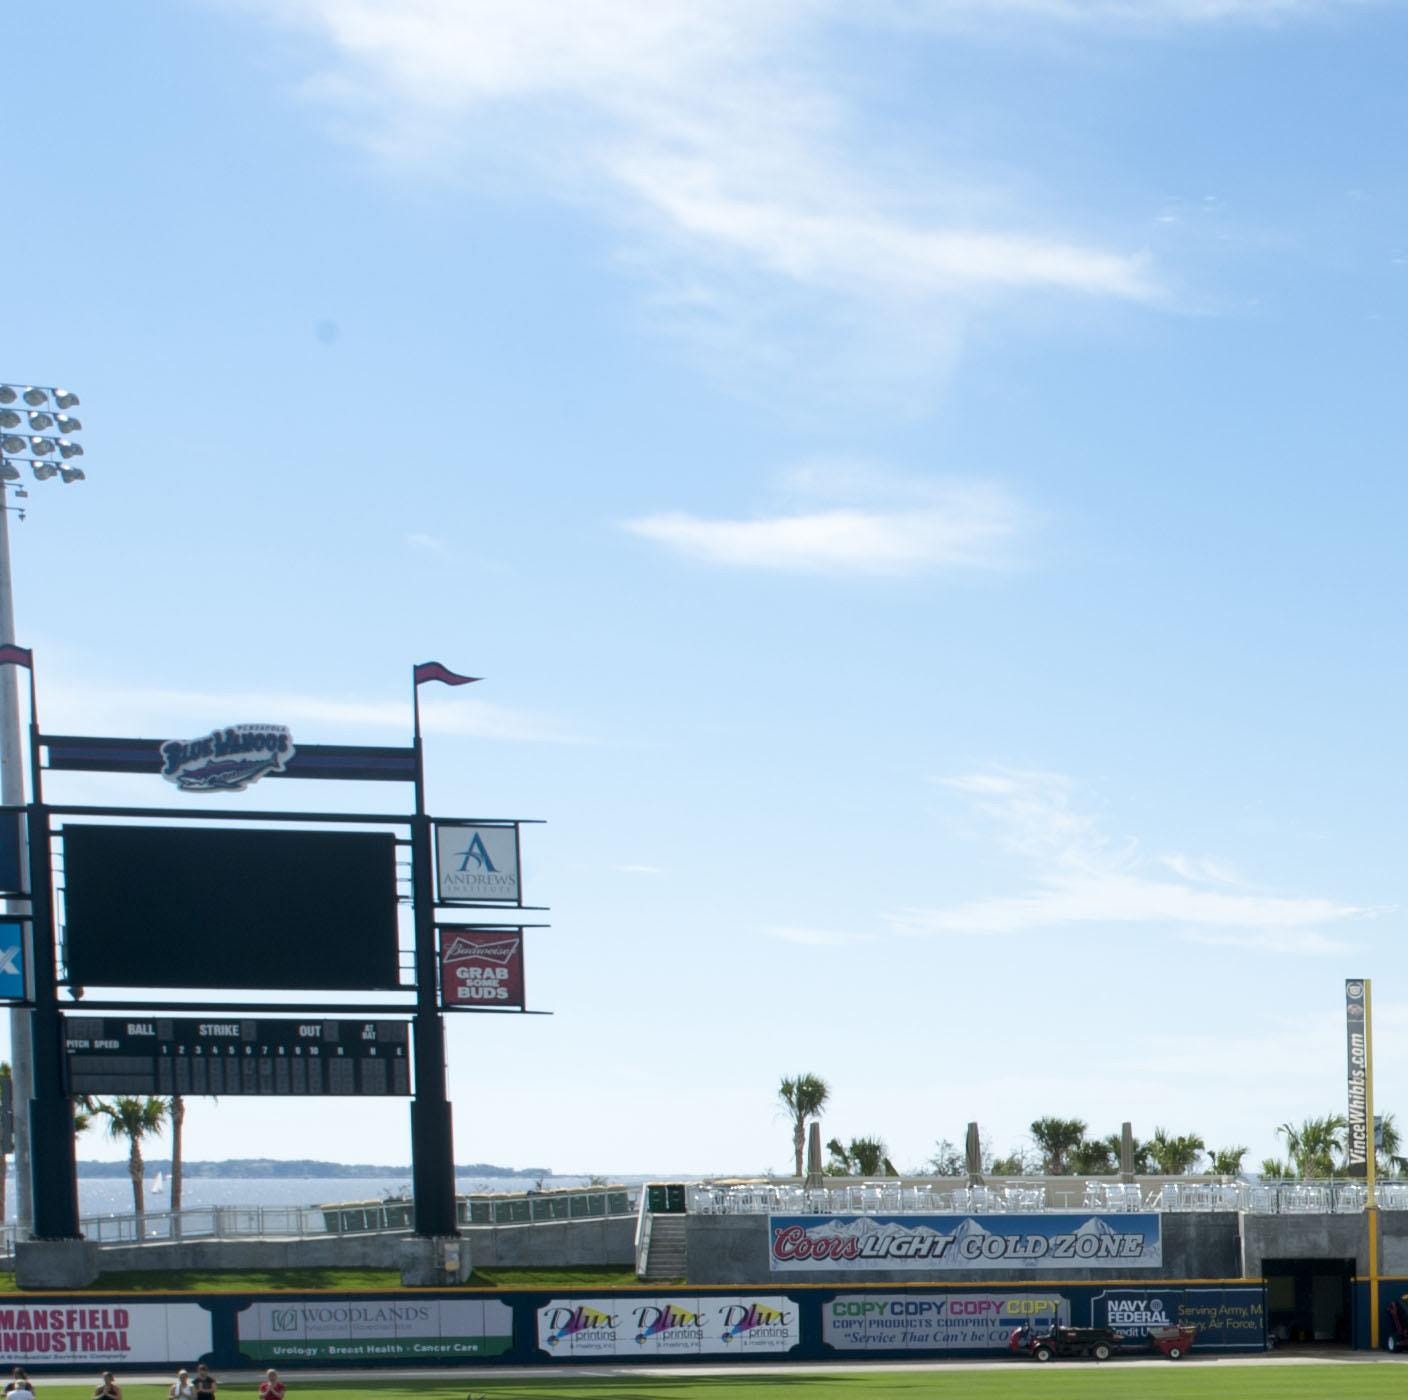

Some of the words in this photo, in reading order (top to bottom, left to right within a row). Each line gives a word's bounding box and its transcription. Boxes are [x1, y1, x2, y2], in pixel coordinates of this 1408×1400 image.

[444, 873, 516, 886] ANDREWS
[456, 967, 509, 980] GRAB
[457, 987, 508, 999] BUDS
[127, 1023, 155, 1036] BALL
[198, 1024, 240, 1037] STRIKE
[299, 1025, 321, 1037] OUT
[66, 1040, 90, 1048] PITCH
[94, 1040, 120, 1049] SPEED
[162, 1046, 167, 1054] 1
[178, 1046, 184, 1054] 2
[195, 1046, 201, 1054] 3
[212, 1046, 218, 1054] 4
[229, 1046, 235, 1054] 5
[262, 1047, 268, 1055] 7
[310, 1047, 319, 1055] 10
[1349, 1032, 1366, 1165] VinceWhibbs.com
[773, 1226, 858, 1260] Coors
[858, 1234, 956, 1259] LIGHT
[959, 1234, 1049, 1259] COLD
[1053, 1233, 1145, 1258] ZONE
[832, 1302, 889, 1316] COPY
[890, 1302, 946, 1316] COPY
[949, 1301, 1005, 1315] COPY
[1108, 1300, 1147, 1311] NAVY
[1178, 1304, 1216, 1318] Serving
[1219, 1304, 1248, 1316] Army,
[0, 1309, 129, 1330] MANSFIELD
[303, 1307, 431, 1322] WOODLANDS
[544, 1305, 623, 1330] Dlux
[633, 1304, 709, 1329] Dlux
[718, 1303, 795, 1328] Dlux
[1108, 1311, 1169, 1323] FEDERAL
[832, 1319, 864, 1329] COPY
[869, 1318, 931, 1328] PRODUCTS
[937, 1318, 996, 1328] COMPANY
[1209, 1318, 1225, 1328] Air
[1226, 1318, 1257, 1330] Force,
[576, 1330, 616, 1342] printing
[663, 1329, 703, 1342] printing
[749, 1327, 789, 1339] printing
[901, 1331, 929, 1343] That
[933, 1330, 967, 1343] Can't
[971, 1330, 985, 1342] be
[273, 1346, 318, 1357] Urology
[329, 1345, 364, 1355] Breast
[366, 1344, 403, 1354] Health
[413, 1343, 451, 1353] Cancer
[454, 1343, 479, 1352] Care
